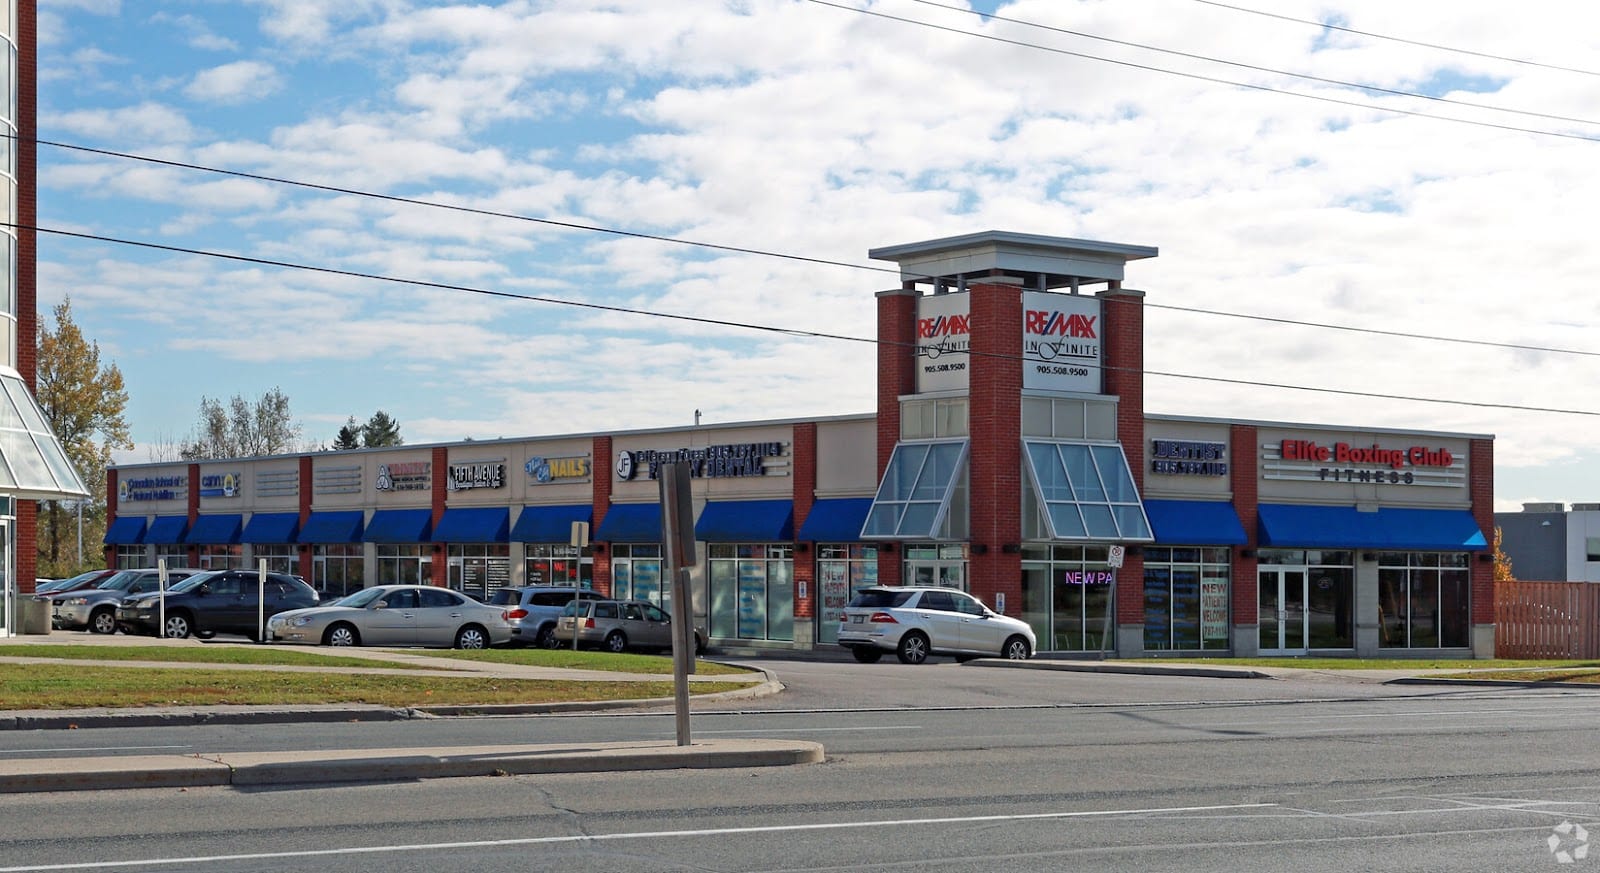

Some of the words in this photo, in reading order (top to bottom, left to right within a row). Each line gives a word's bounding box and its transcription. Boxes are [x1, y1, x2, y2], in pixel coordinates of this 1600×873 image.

[918, 314, 970, 339] RE/MAX
[1026, 310, 1097, 339] RE/MAX
[925, 362, 966, 373] 905.508.9500
[1036, 365, 1089, 377] 905.508.9500
[1154, 440, 1226, 459] DENTIST
[1281, 439, 1329, 462] Elite
[1335, 442, 1404, 469] Boxing
[1409, 446, 1453, 466] Club
[455, 466, 473, 481] FIFTH
[474, 464, 500, 481] AVENUE
[549, 458, 586, 478] NAILS
[706, 456, 762, 478] DENTAL
[1319, 468, 1414, 485] FITNESS
[1065, 571, 1096, 584] NEW
[1202, 584, 1226, 593] NEW
